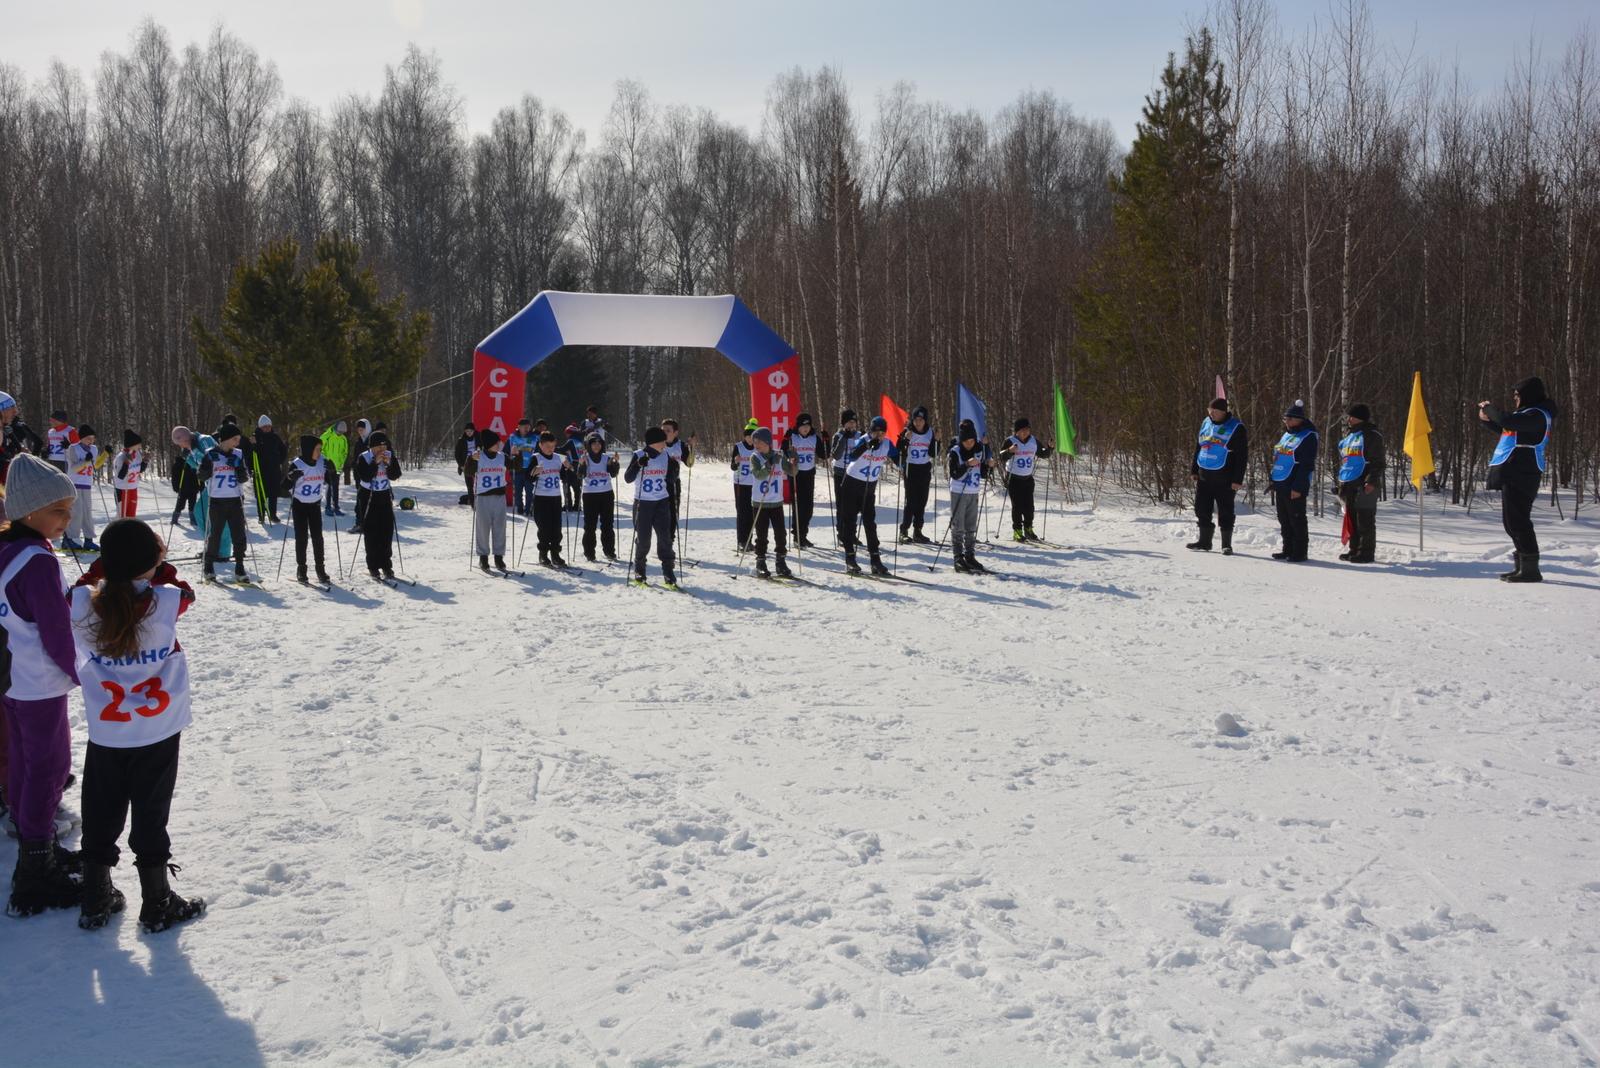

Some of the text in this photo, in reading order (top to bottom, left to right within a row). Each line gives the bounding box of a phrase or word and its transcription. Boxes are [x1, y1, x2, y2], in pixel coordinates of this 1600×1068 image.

[49, 444, 64, 455] 22
[911, 449, 929, 459] 97
[798, 454, 813, 464] 56
[1017, 457, 1032, 469] 99
[77, 466, 93, 477] 28
[741, 465, 753, 476] 5
[859, 465, 881, 478] 40
[128, 472, 141, 483] 27
[215, 474, 238, 489] 75
[482, 475, 501, 488] 81
[544, 477, 560, 488] 86
[961, 472, 980, 487] 43
[301, 484, 321, 497] 84
[642, 478, 663, 493] 83
[760, 480, 779, 494] 61
[99, 677, 170, 723] 23
